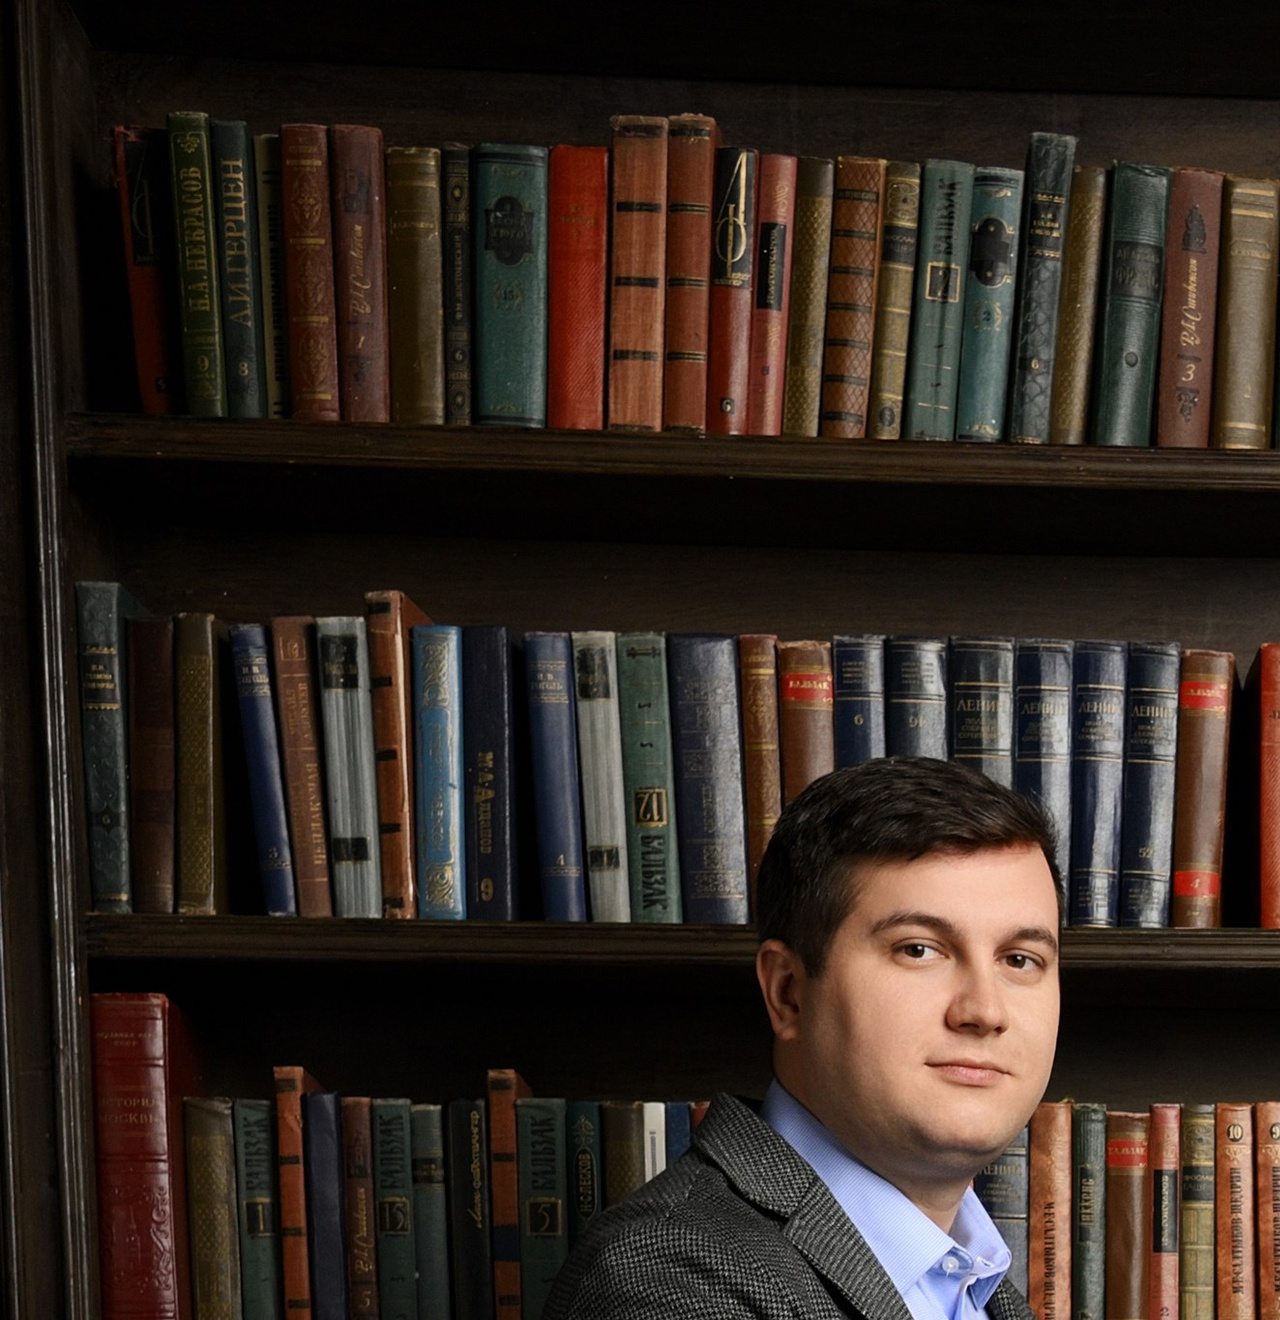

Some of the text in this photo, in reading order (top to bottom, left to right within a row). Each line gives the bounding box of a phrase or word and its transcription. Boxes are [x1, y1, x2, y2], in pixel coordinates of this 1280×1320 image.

[180, 166, 213, 313] Н.А. НЕКРАСОВ
[238, 361, 250, 377] 8
[1182, 362, 1195, 381] 3
[721, 399, 731, 412] 6
[956, 699, 1008, 713] ЛЕНИН
[1021, 702, 1066, 716] ЛЕНИН
[1078, 702, 1121, 715] ЛЕНИН
[1131, 705, 1173, 718] ЛЕНИН
[640, 791, 663, 823] 12
[641, 834, 669, 910] БАЛЬЗАК
[1228, 1124, 1243, 1139] 10
[1271, 1125, 1280, 1139] 9
[245, 1113, 272, 1192] БАЛЬЗАК
[382, 1115, 405, 1190] БАЛЬЗАК
[531, 1114, 558, 1191] БАЛЬЗАК
[256, 1203, 266, 1233] 1
[383, 1202, 409, 1233] 15
[537, 1207, 552, 1232] 5
[360, 1290, 372, 1308] 5
[1160, 1306, 1170, 1318] 2
